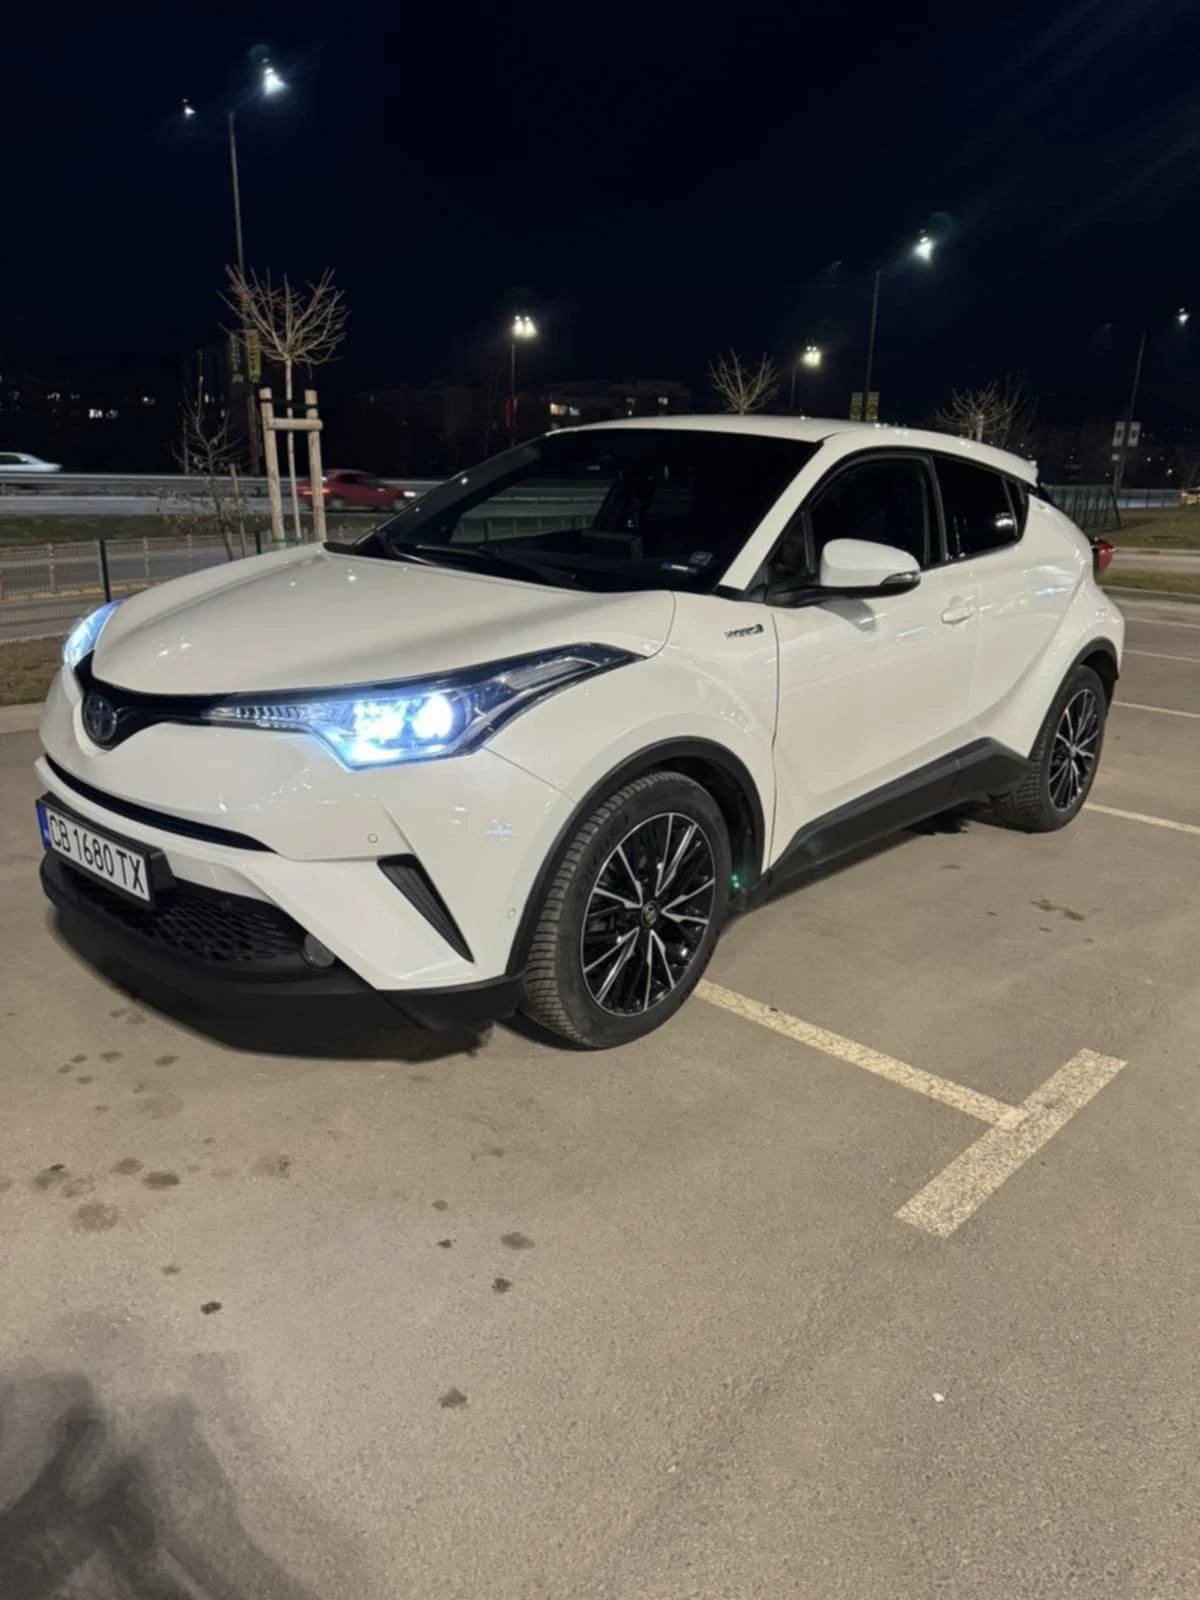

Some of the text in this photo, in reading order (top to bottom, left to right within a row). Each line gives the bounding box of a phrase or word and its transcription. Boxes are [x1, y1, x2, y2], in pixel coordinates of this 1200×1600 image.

[49, 815, 145, 895] CB 1680 TX
